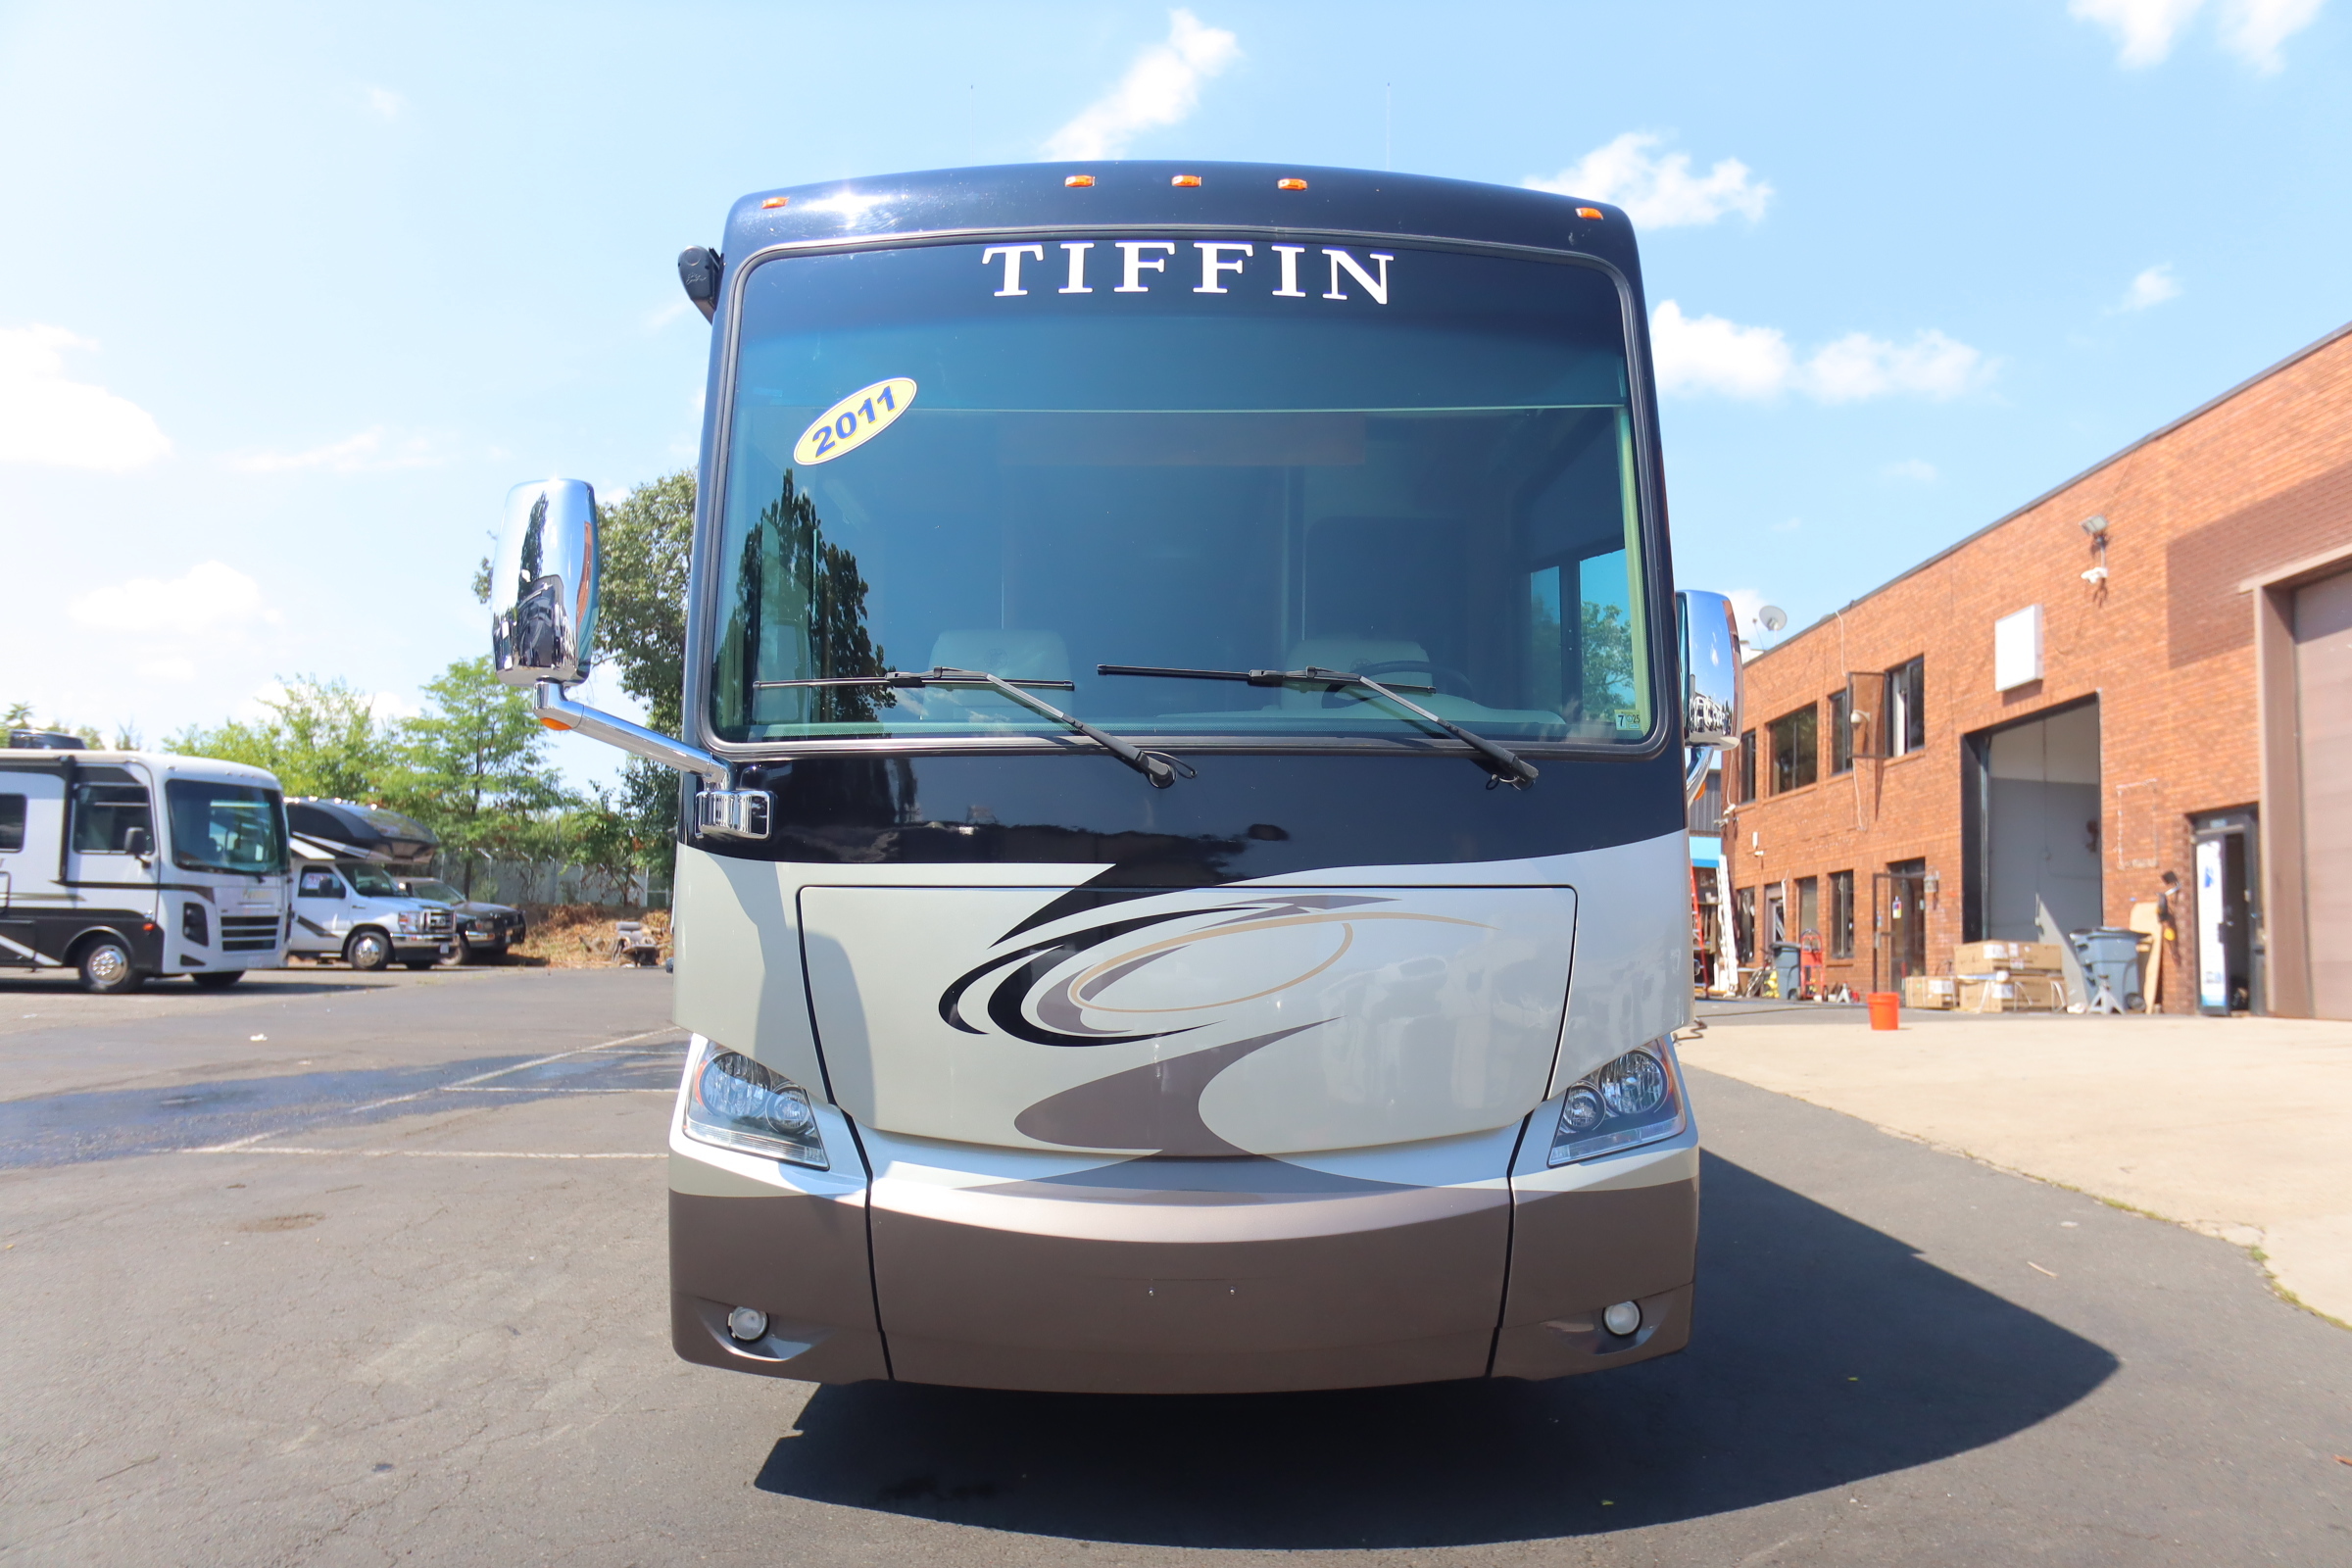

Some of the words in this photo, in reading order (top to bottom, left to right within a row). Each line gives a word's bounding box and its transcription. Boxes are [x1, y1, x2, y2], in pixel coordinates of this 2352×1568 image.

[981, 241, 1395, 305] TIFFIN
[811, 385, 897, 459] 2011
[1617, 714, 1625, 727] 7
[1632, 713, 1641, 724] 25
